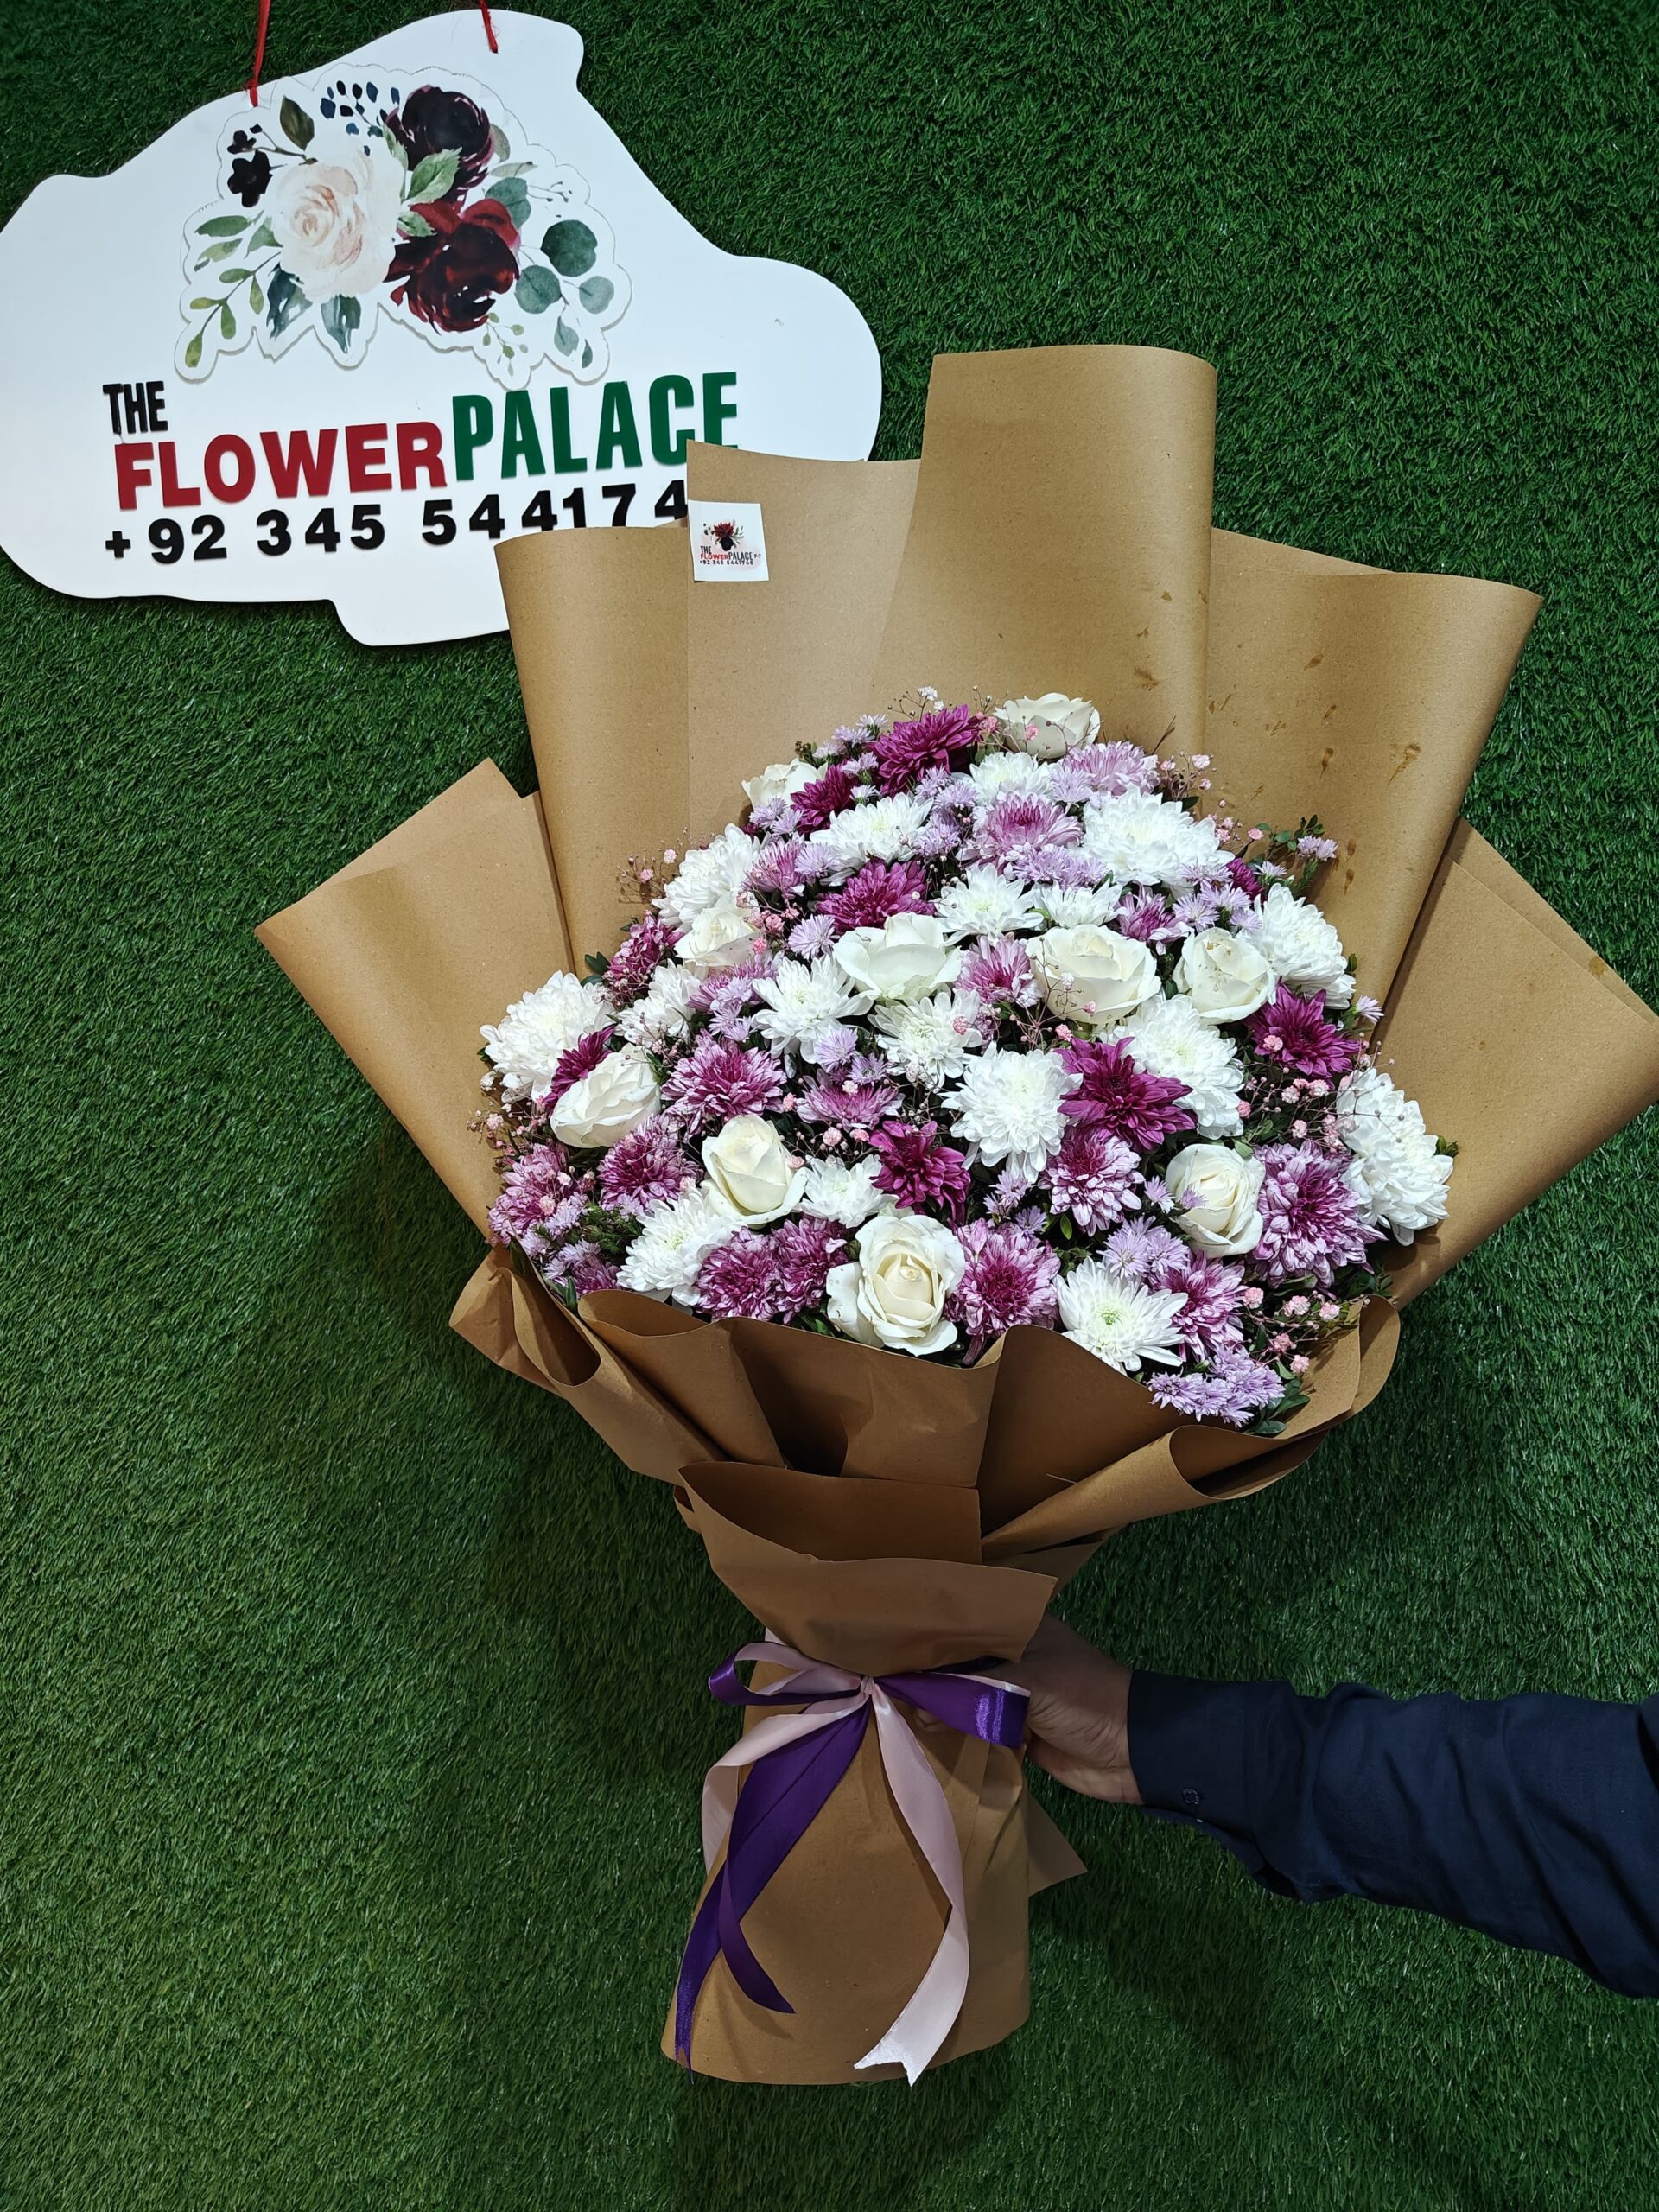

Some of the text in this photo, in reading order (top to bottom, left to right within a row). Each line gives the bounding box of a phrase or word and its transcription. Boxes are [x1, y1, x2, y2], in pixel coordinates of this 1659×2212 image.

[103, 381, 168, 435] THE
[105, 515, 227, 564] +92
[256, 504, 385, 556] 345
[700, 545, 711, 554] THE
